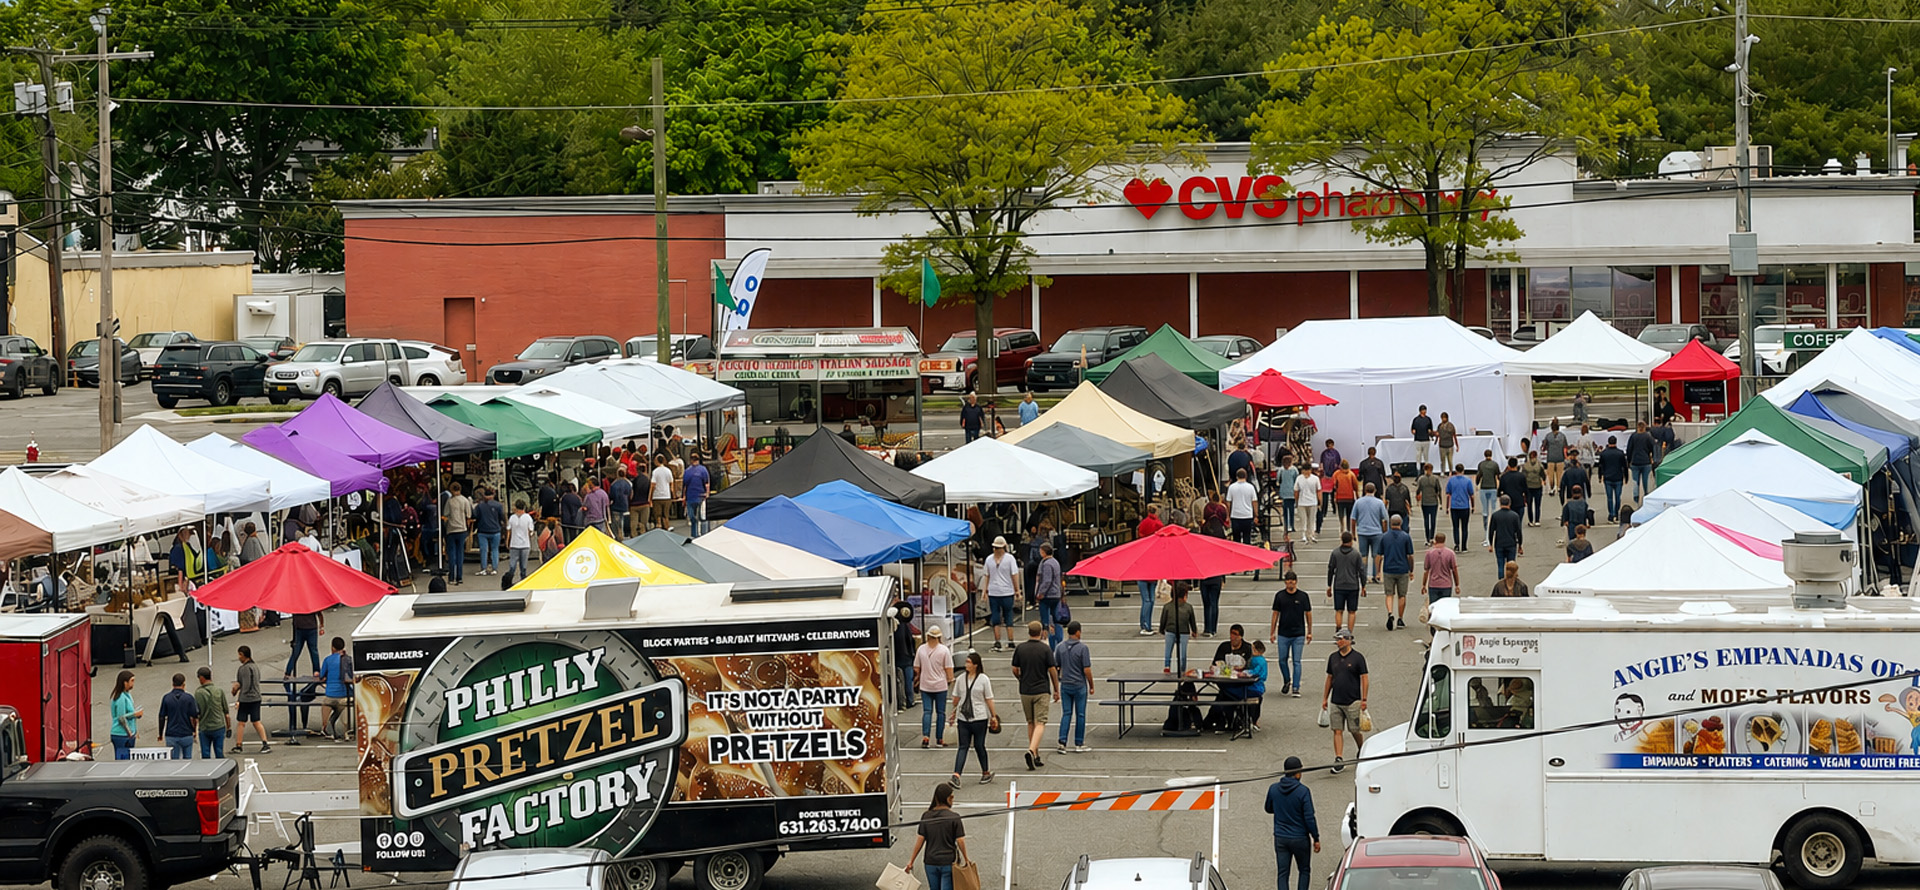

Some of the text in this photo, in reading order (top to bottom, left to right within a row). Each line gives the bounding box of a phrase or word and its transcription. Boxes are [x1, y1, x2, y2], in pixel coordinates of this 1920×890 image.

[1178, 175, 1289, 221] CVS
[820, 358, 862, 370] ITALIAN
[643, 637, 673, 648] BLOCK
[673, 636, 710, 647] PARTIES
[716, 634, 754, 645] BAR/BAT
[806, 629, 871, 642] CELEBRATIONS
[366, 650, 424, 661] FUNDRAISERS
[1612, 650, 1709, 690] ANGIE'S
[1716, 646, 1864, 674] EMPANADAS
[445, 648, 604, 728] PHILLY
[1667, 689, 1872, 705] and MOE'S FLAVORS
[708, 691, 741, 709] IT'S
[744, 690, 786, 708] NOT
[802, 687, 862, 706] PARTY
[749, 710, 824, 728] WITHOUT
[428, 698, 659, 799] PRETZEL
[710, 729, 866, 763] PRETZELS
[1708, 756, 1753, 767] PLATTERS
[1764, 756, 1809, 768] CATERING
[1820, 757, 1851, 768] VEGAN
[1898, 757, 1920, 768] FREE
[459, 761, 658, 850] FACTORY
[779, 817, 882, 834] 631.263.7400
[376, 850, 410, 859] FOLLOW
